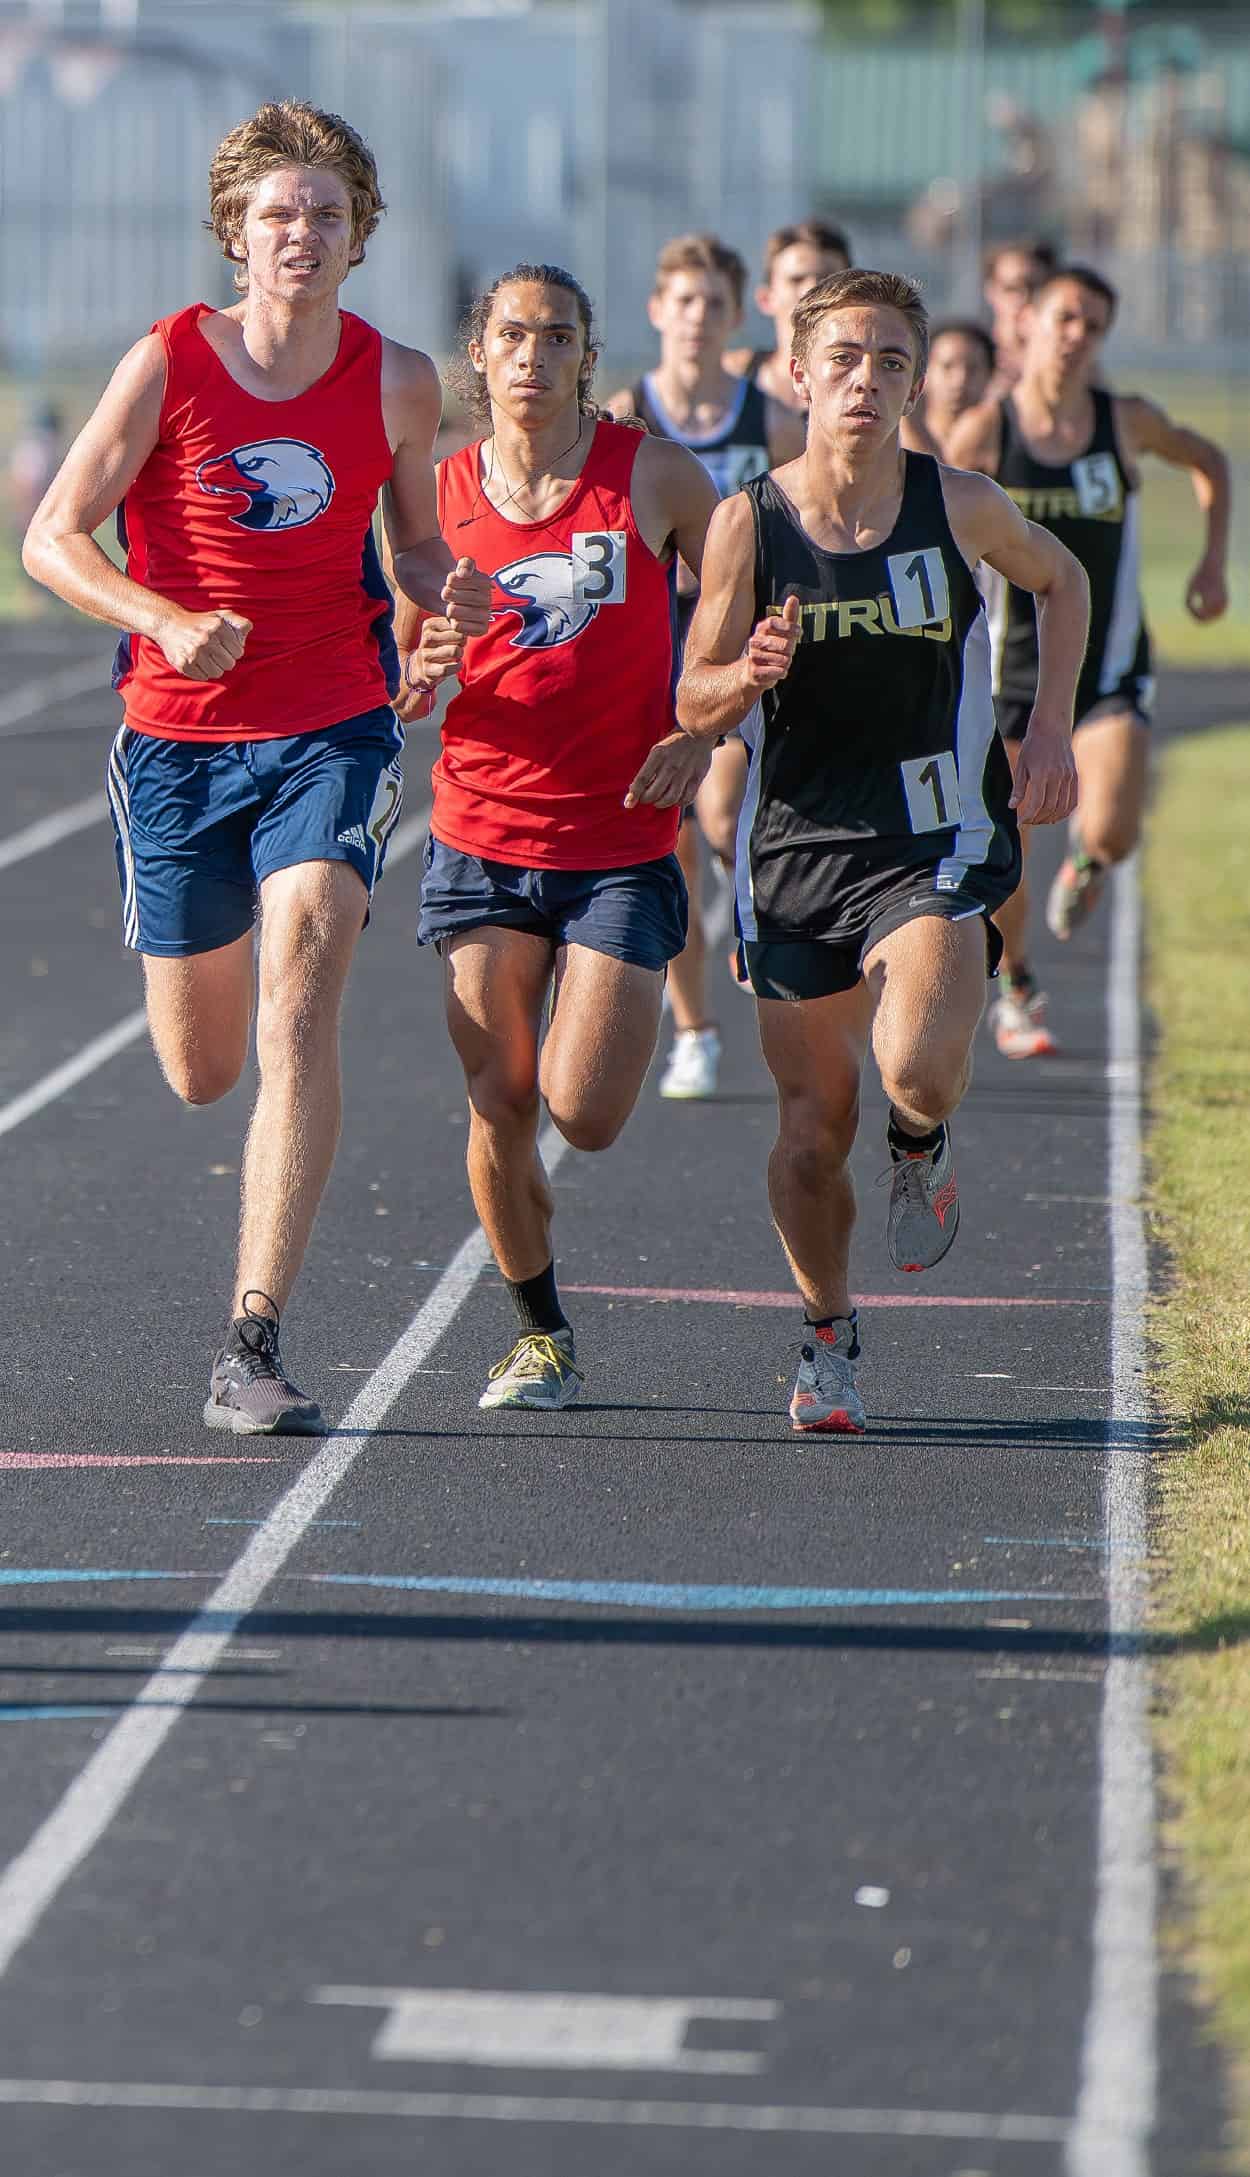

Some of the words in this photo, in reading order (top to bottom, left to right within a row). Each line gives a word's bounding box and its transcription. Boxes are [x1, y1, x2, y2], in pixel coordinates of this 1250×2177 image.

[1086, 459, 1110, 509] 5
[583, 535, 614, 600] 3
[904, 555, 936, 618] 1
[371, 780, 399, 846] 2
[918, 759, 948, 825] 1
